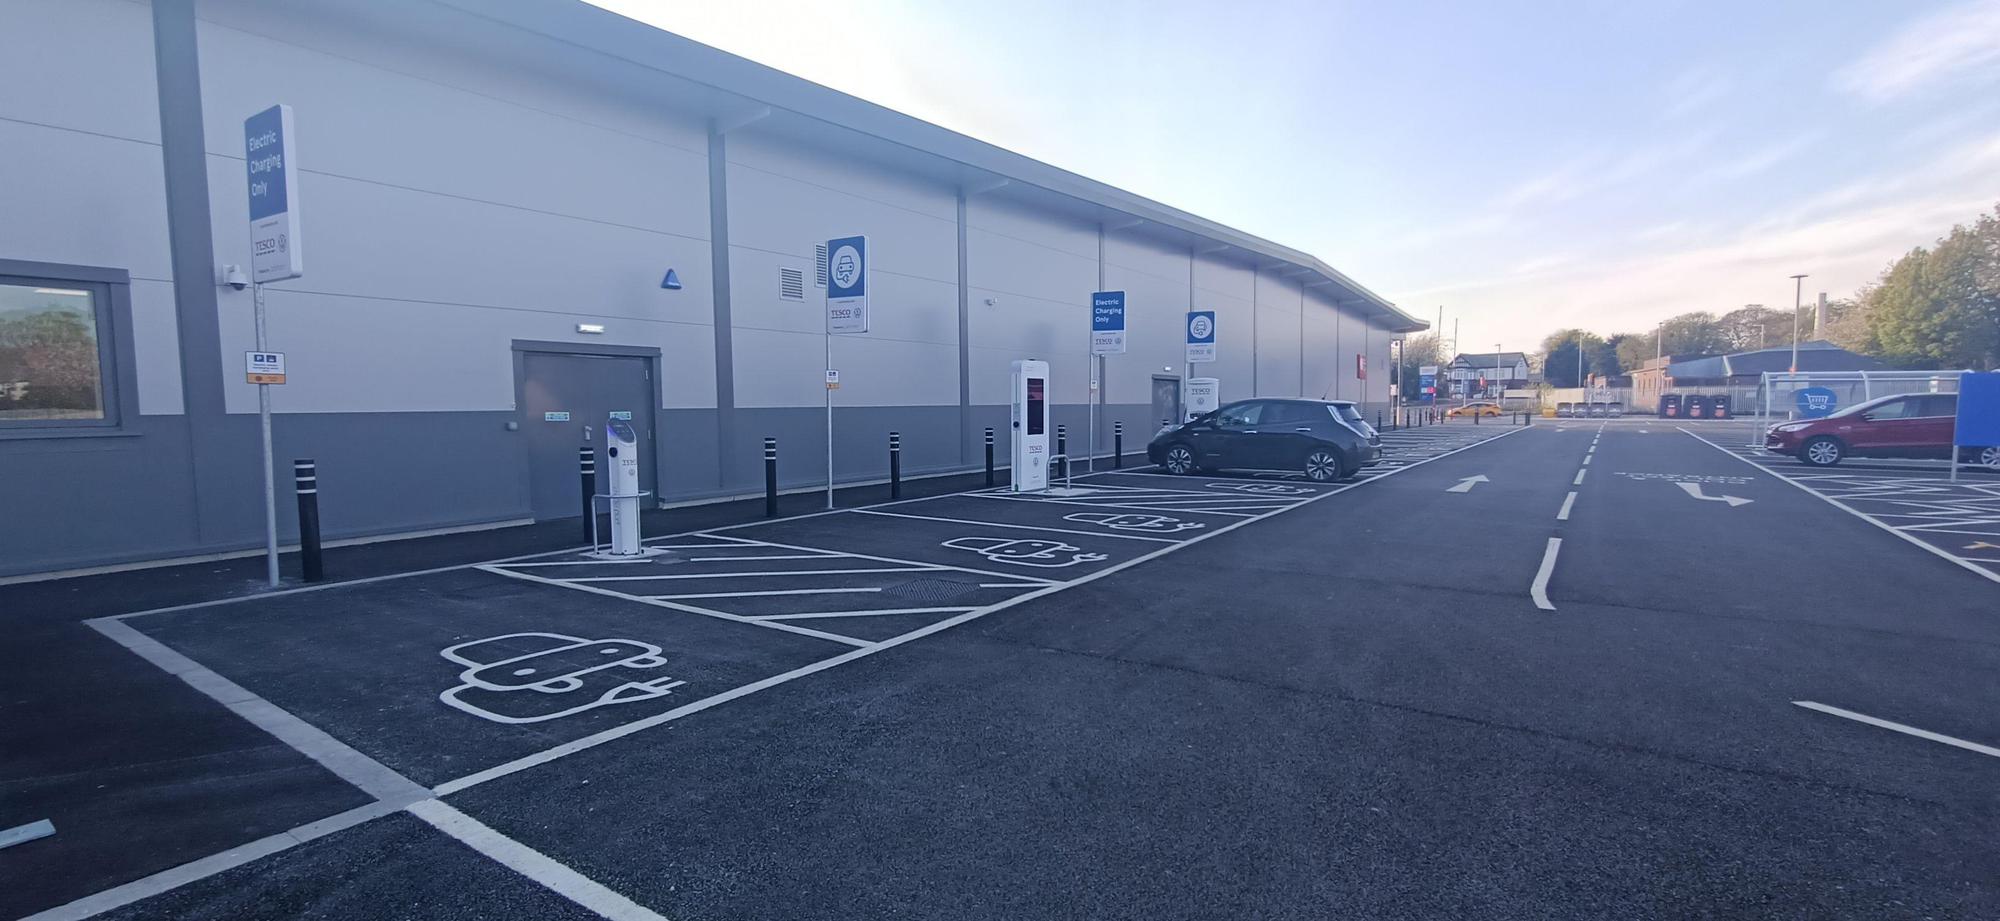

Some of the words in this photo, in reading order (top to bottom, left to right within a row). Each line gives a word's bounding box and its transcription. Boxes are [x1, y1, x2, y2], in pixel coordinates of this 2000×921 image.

[249, 130, 277, 151] Electric
[250, 153, 282, 174] Charging
[252, 180, 268, 197] Only
[255, 239, 275, 251] TESCO
[1095, 298, 1119, 306] Electric
[1095, 307, 1122, 315] Charging
[1095, 316, 1109, 324] Only
